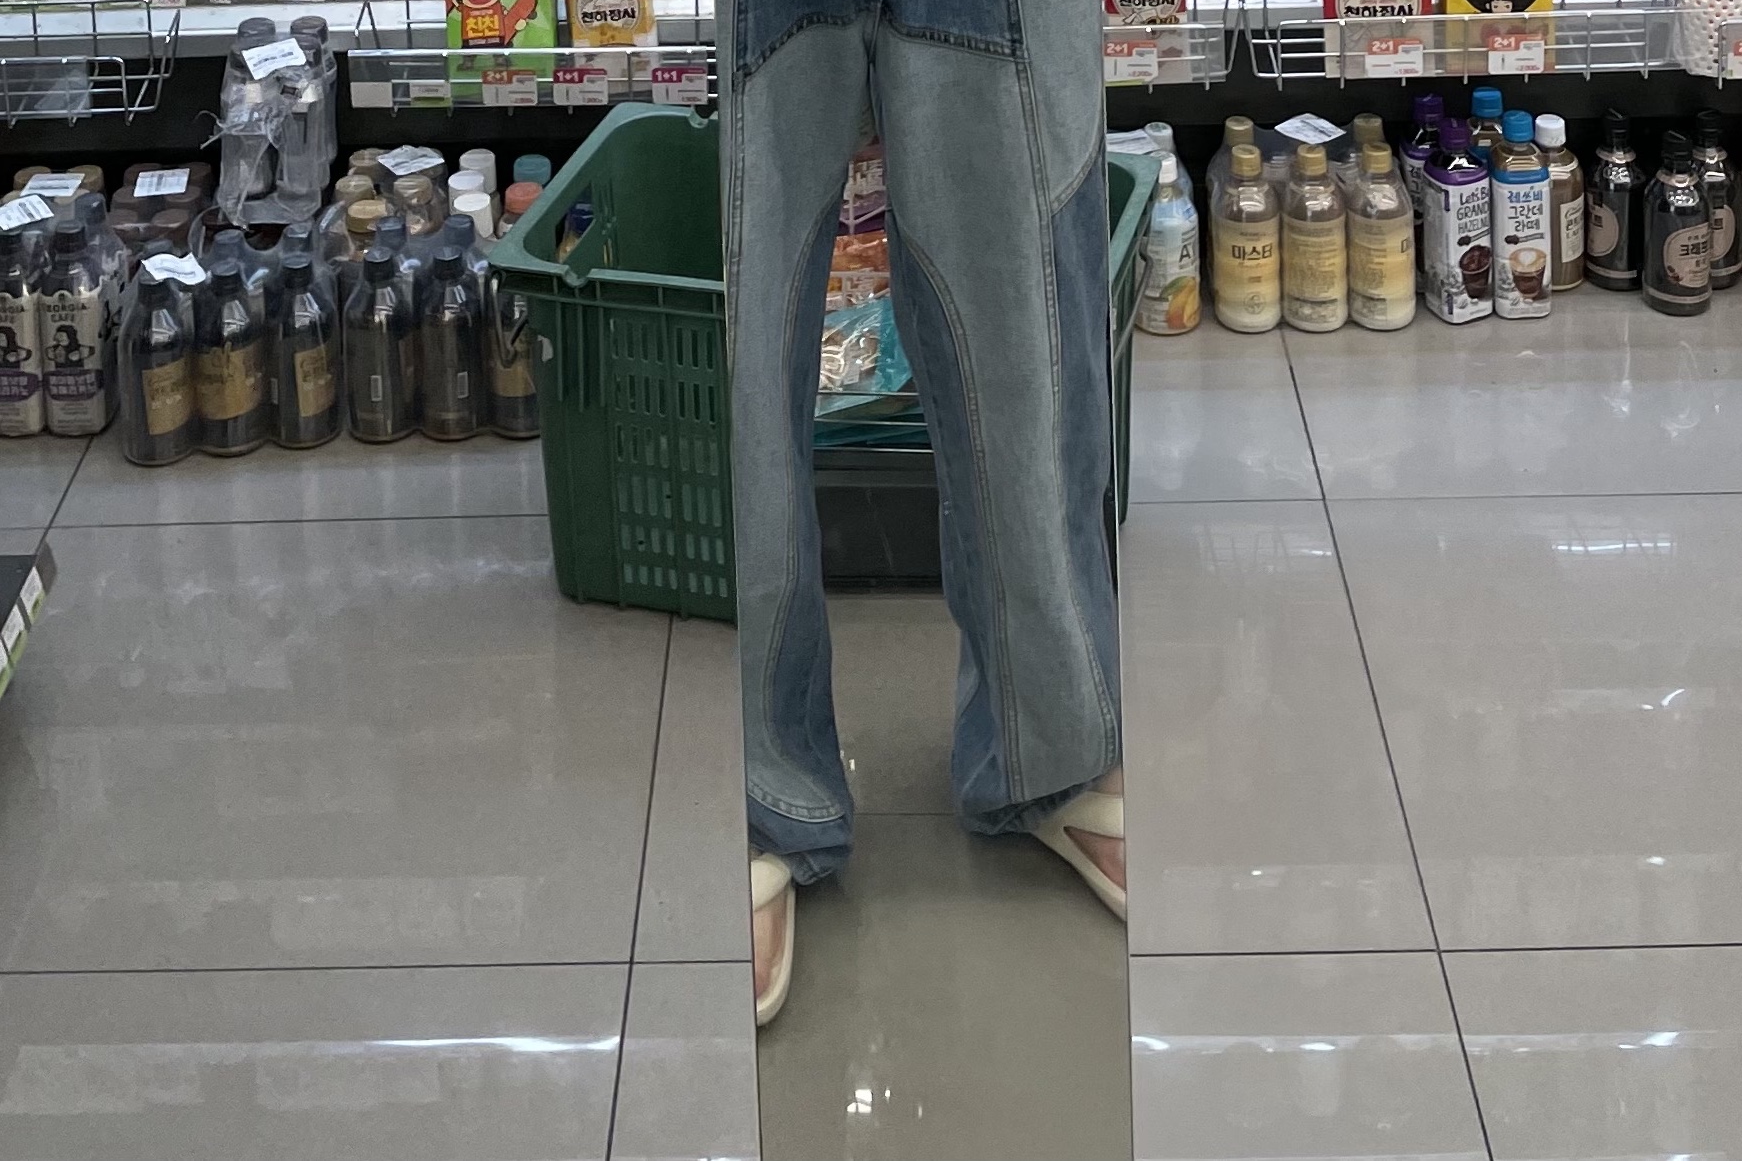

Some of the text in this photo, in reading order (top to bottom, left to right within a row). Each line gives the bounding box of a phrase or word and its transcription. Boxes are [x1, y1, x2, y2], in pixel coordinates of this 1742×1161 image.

[581, 9, 636, 24] 천하장사
[1344, 4, 1414, 17] 천하장사
[1372, 41, 1393, 51] 2+1
[656, 71, 678, 81] 1+1
[1507, 191, 1543, 203] 레쓰비
[1508, 205, 1543, 219] 그란데
[1514, 220, 1541, 232] 라떼
